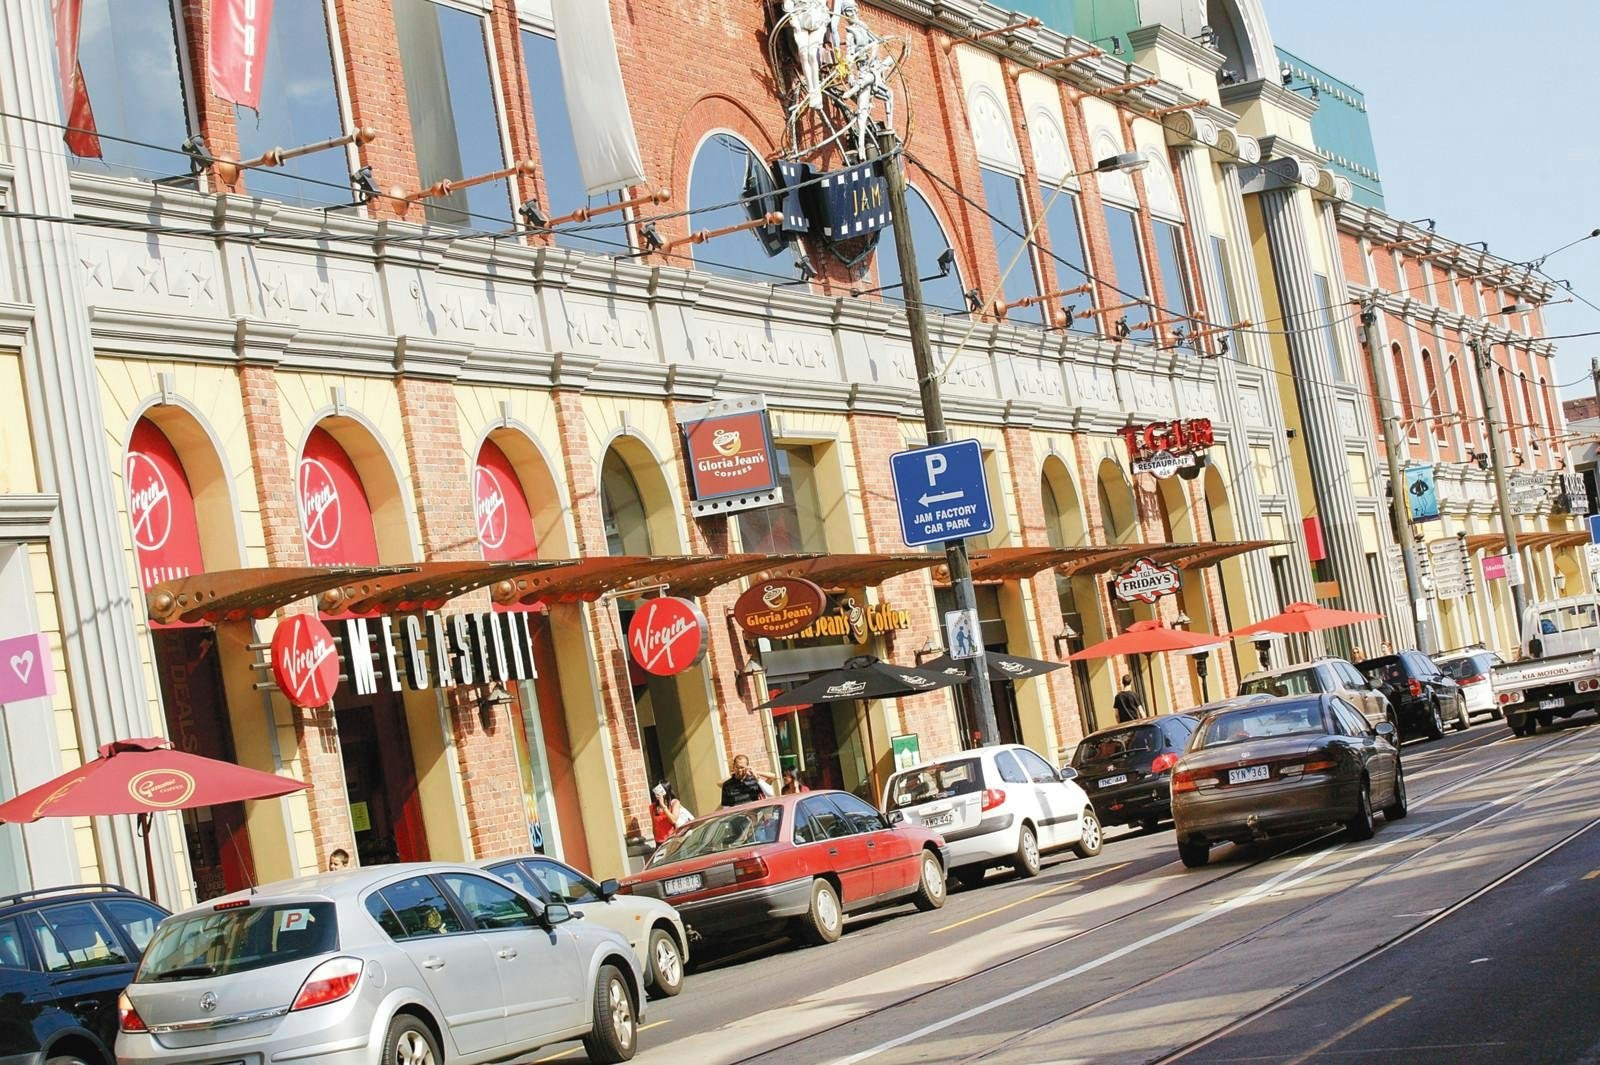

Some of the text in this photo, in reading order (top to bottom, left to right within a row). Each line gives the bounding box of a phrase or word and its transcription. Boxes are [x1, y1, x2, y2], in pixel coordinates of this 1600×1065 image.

[853, 183, 881, 217] JAM
[698, 453, 765, 472] Gloria Jean's
[714, 465, 753, 477] COFFEES
[926, 453, 948, 487] P
[1138, 457, 1189, 471] RESTAURANT
[914, 504, 977, 524] JAM FACTORY
[924, 517, 971, 534] CAR PARK
[1123, 573, 1171, 591] FRIDAY'S
[746, 605, 812, 626] Gloria Jean's
[763, 618, 799, 631] COFFEES
[866, 602, 912, 633] Coffees
[634, 603, 697, 670] Virgin
[283, 610, 539, 699] Virgin MEGASTORE
[1522, 667, 1569, 680] KIA MOTORS
[285, 912, 303, 929] P
